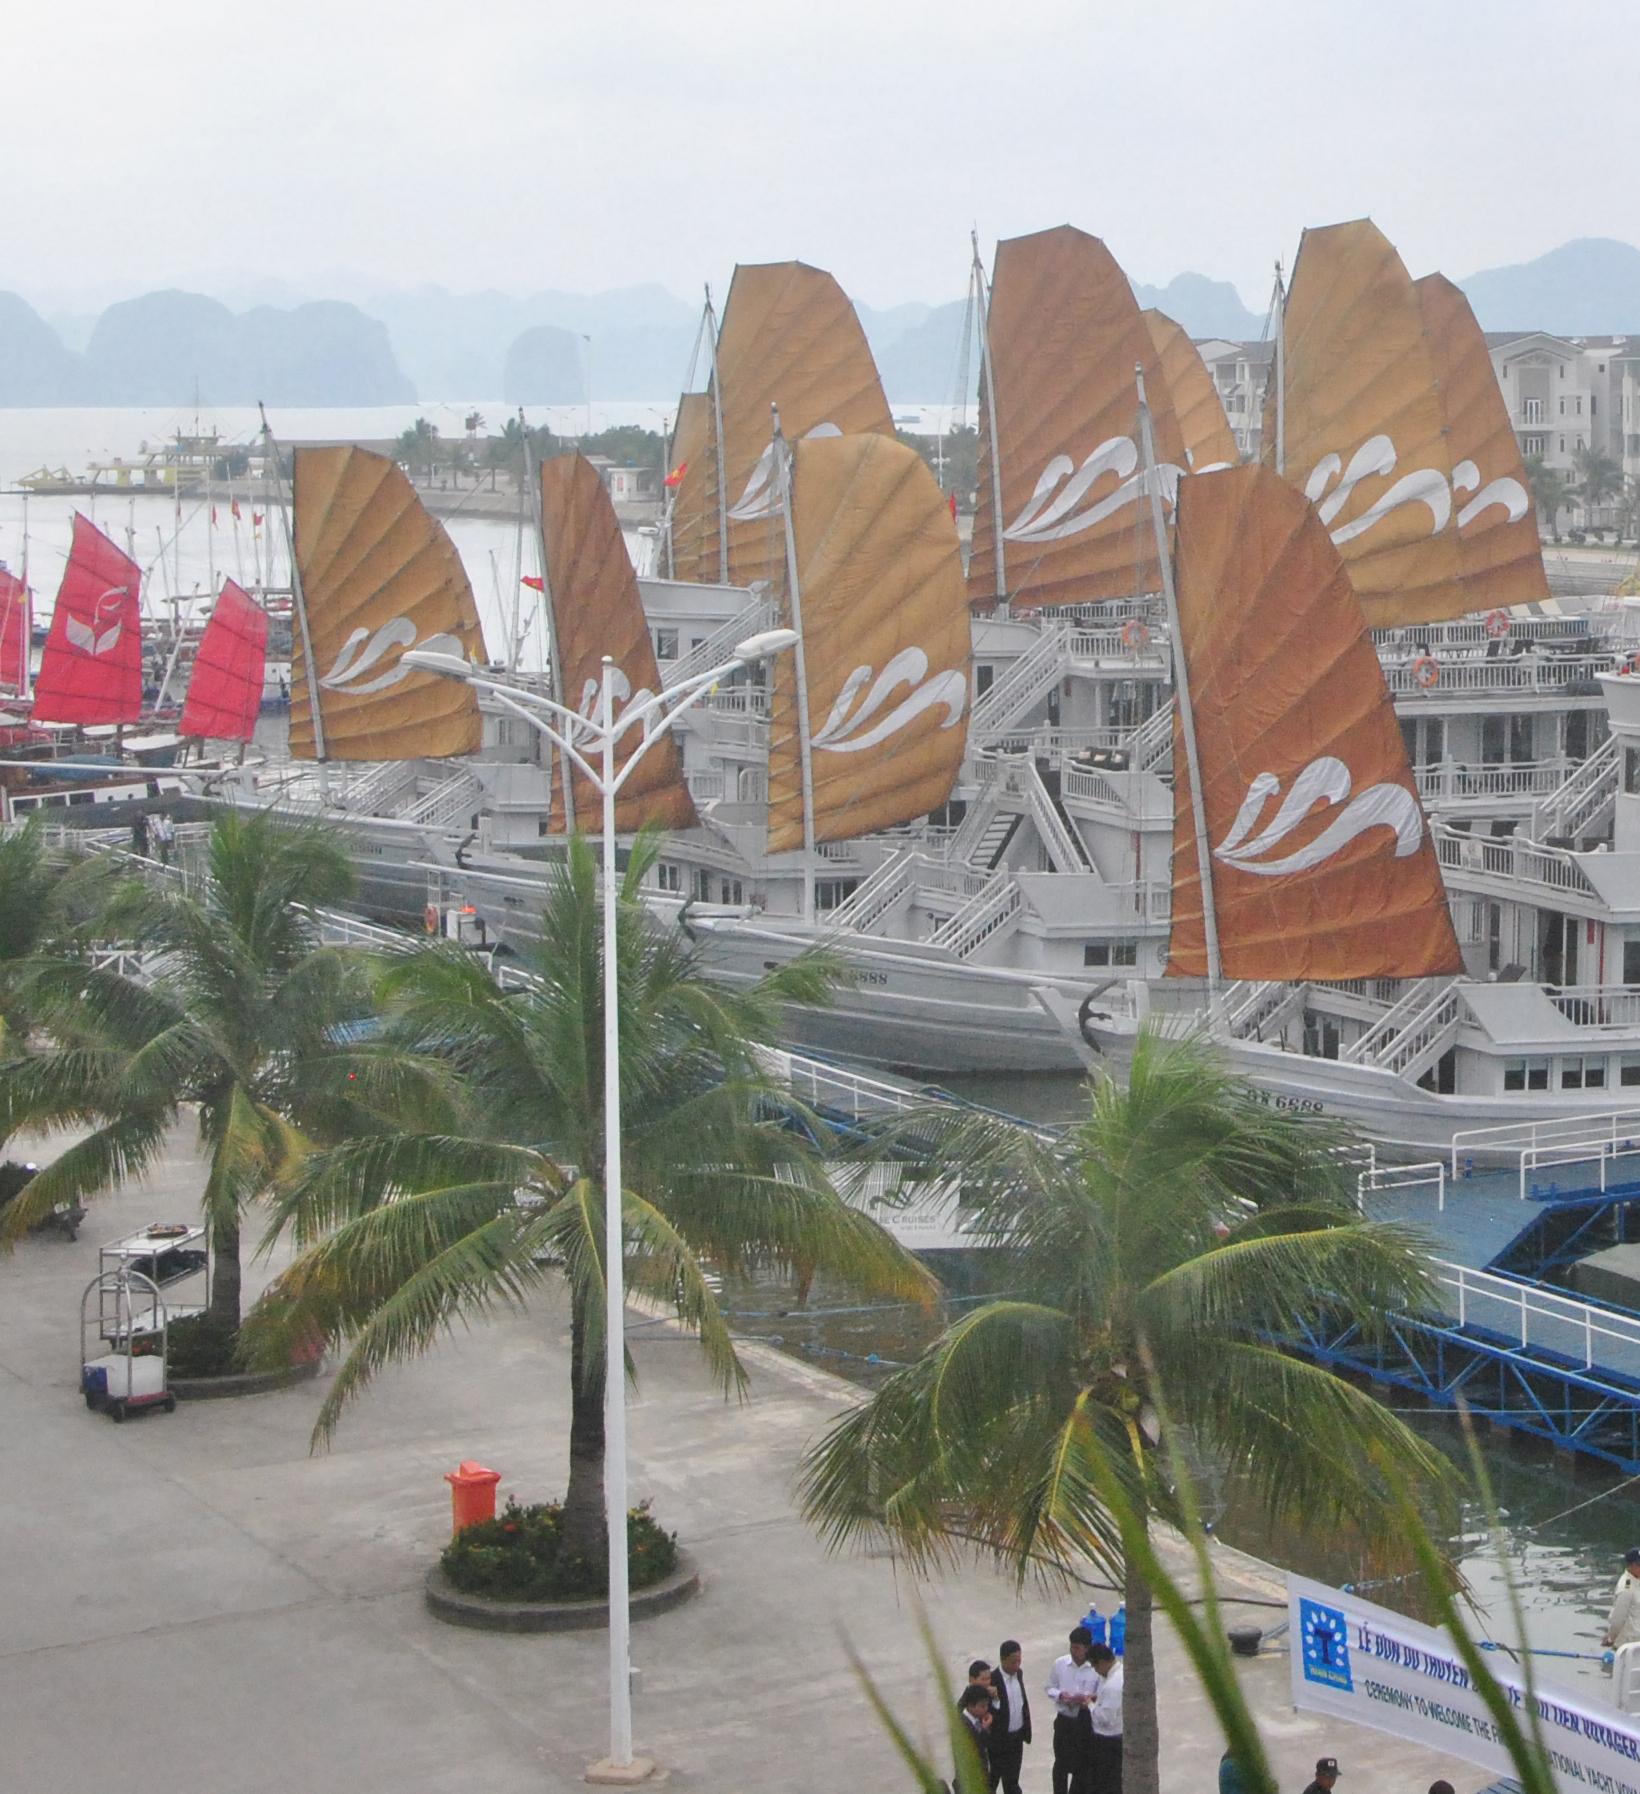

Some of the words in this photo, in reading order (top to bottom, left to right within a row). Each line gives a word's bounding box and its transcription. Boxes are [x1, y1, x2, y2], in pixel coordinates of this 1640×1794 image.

[1364, 1679, 1414, 1713] CEREMONY
[1414, 1695, 1429, 1717] TO
[1428, 1700, 1473, 1733] WELCOME
[1472, 1717, 1492, 1741] THE
[1547, 1750, 1586, 1782] ATIONAL
[1582, 1716, 1640, 1763] VOYAGER
